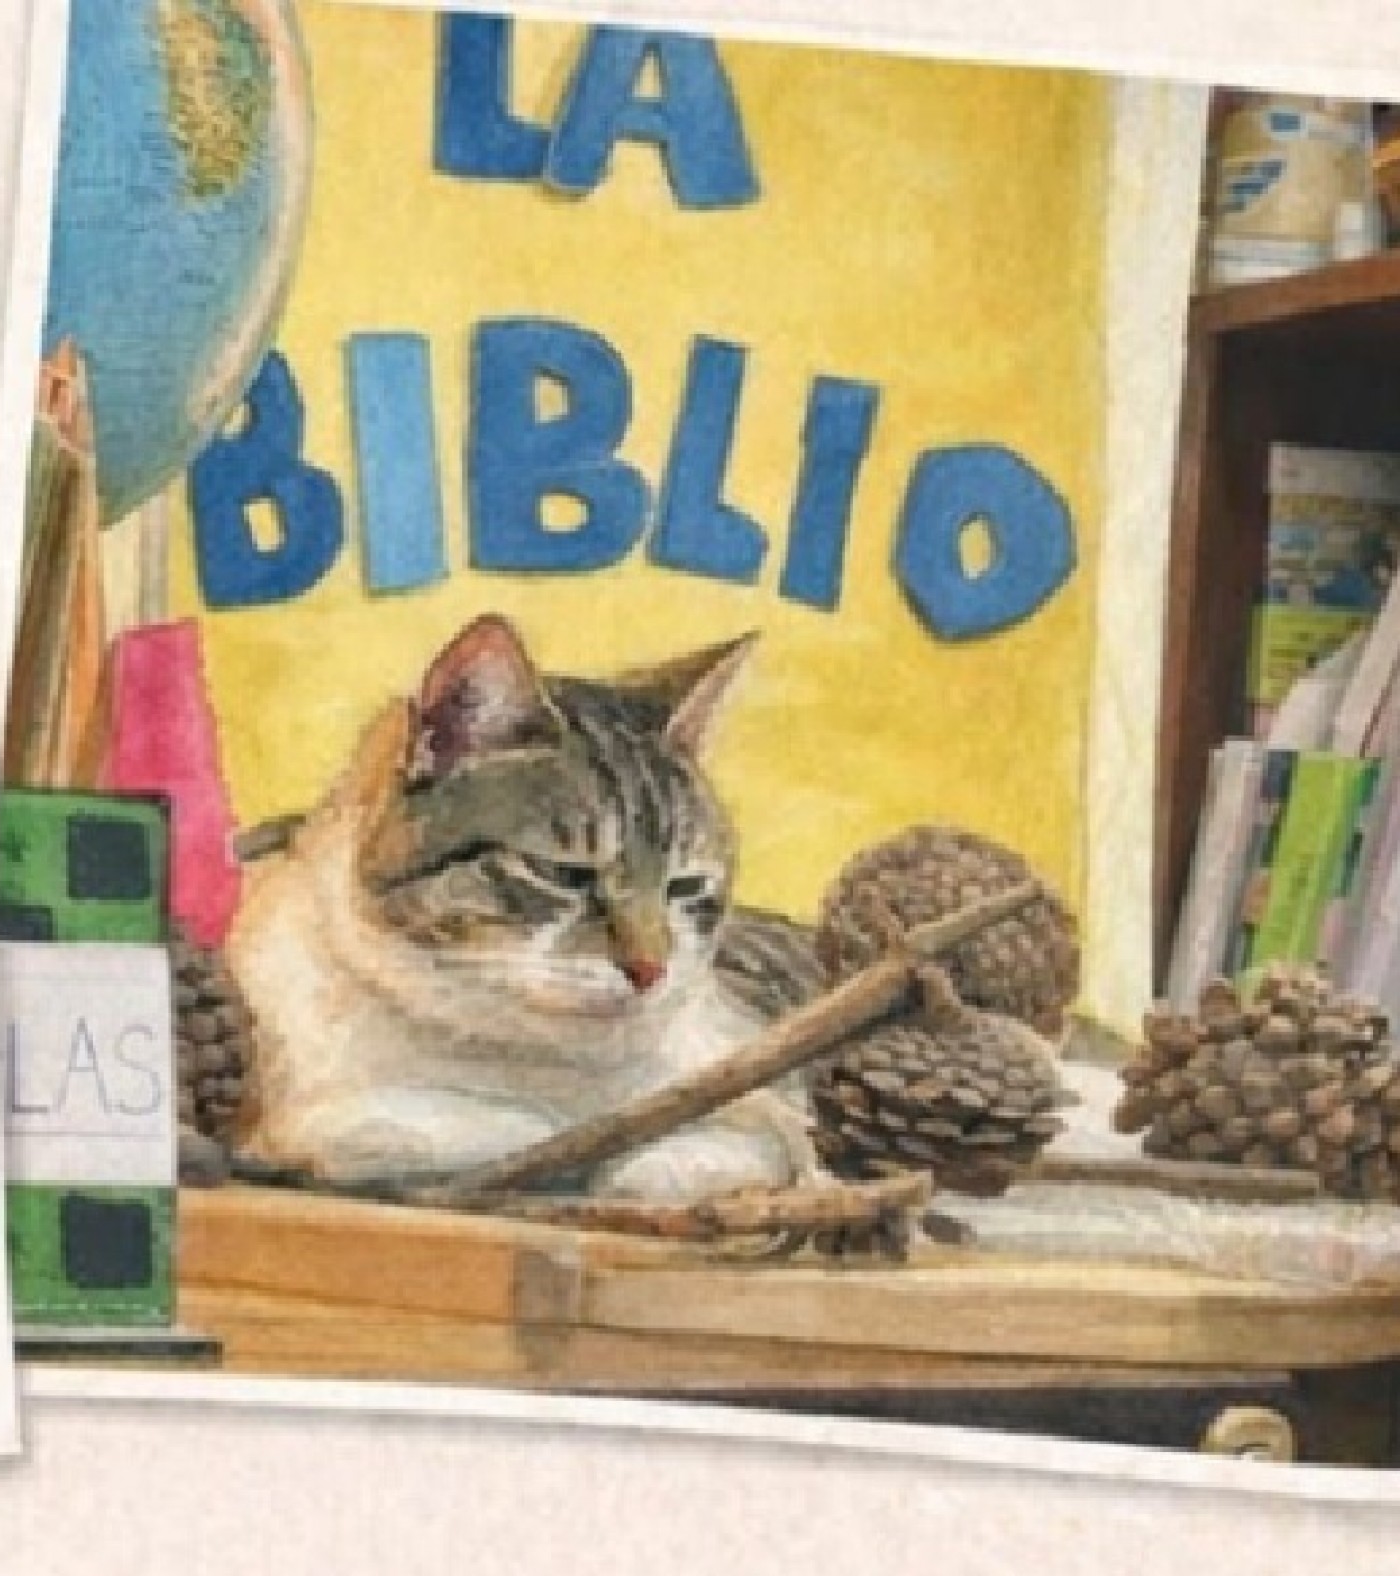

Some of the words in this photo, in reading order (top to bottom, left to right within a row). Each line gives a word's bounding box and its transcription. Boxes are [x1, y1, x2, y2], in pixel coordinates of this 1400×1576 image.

[433, 12, 759, 210] LA
[188, 317, 1077, 643] BIBLIO
[5, 1016, 161, 1115] LAS
